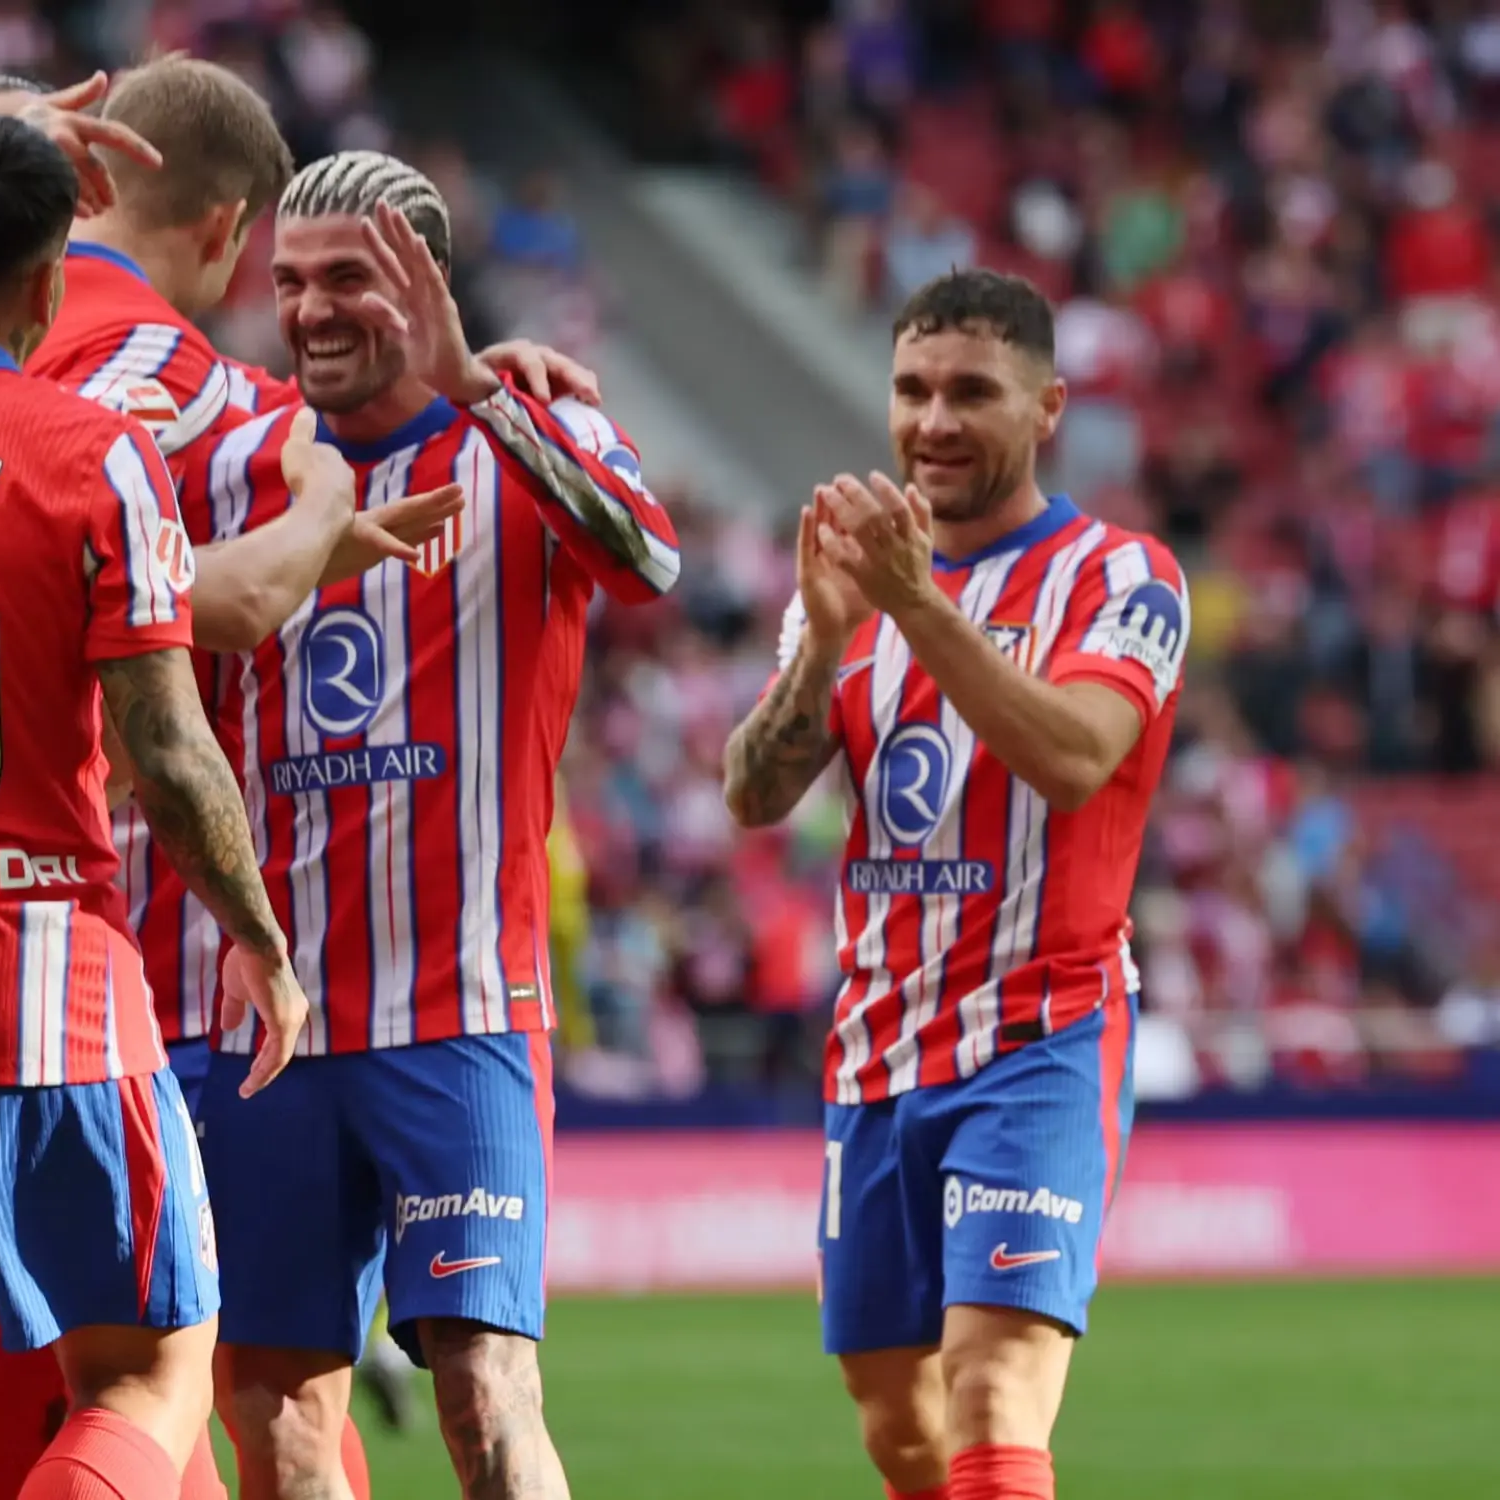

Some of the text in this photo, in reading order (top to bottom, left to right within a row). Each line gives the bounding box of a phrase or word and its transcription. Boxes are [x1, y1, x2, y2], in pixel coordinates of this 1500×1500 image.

[272, 745, 438, 793] RIYADH AIR
[852, 863, 987, 891] RIYADH AIR
[404, 1186, 524, 1224] ComAve
[966, 1183, 1083, 1224] ComAve
